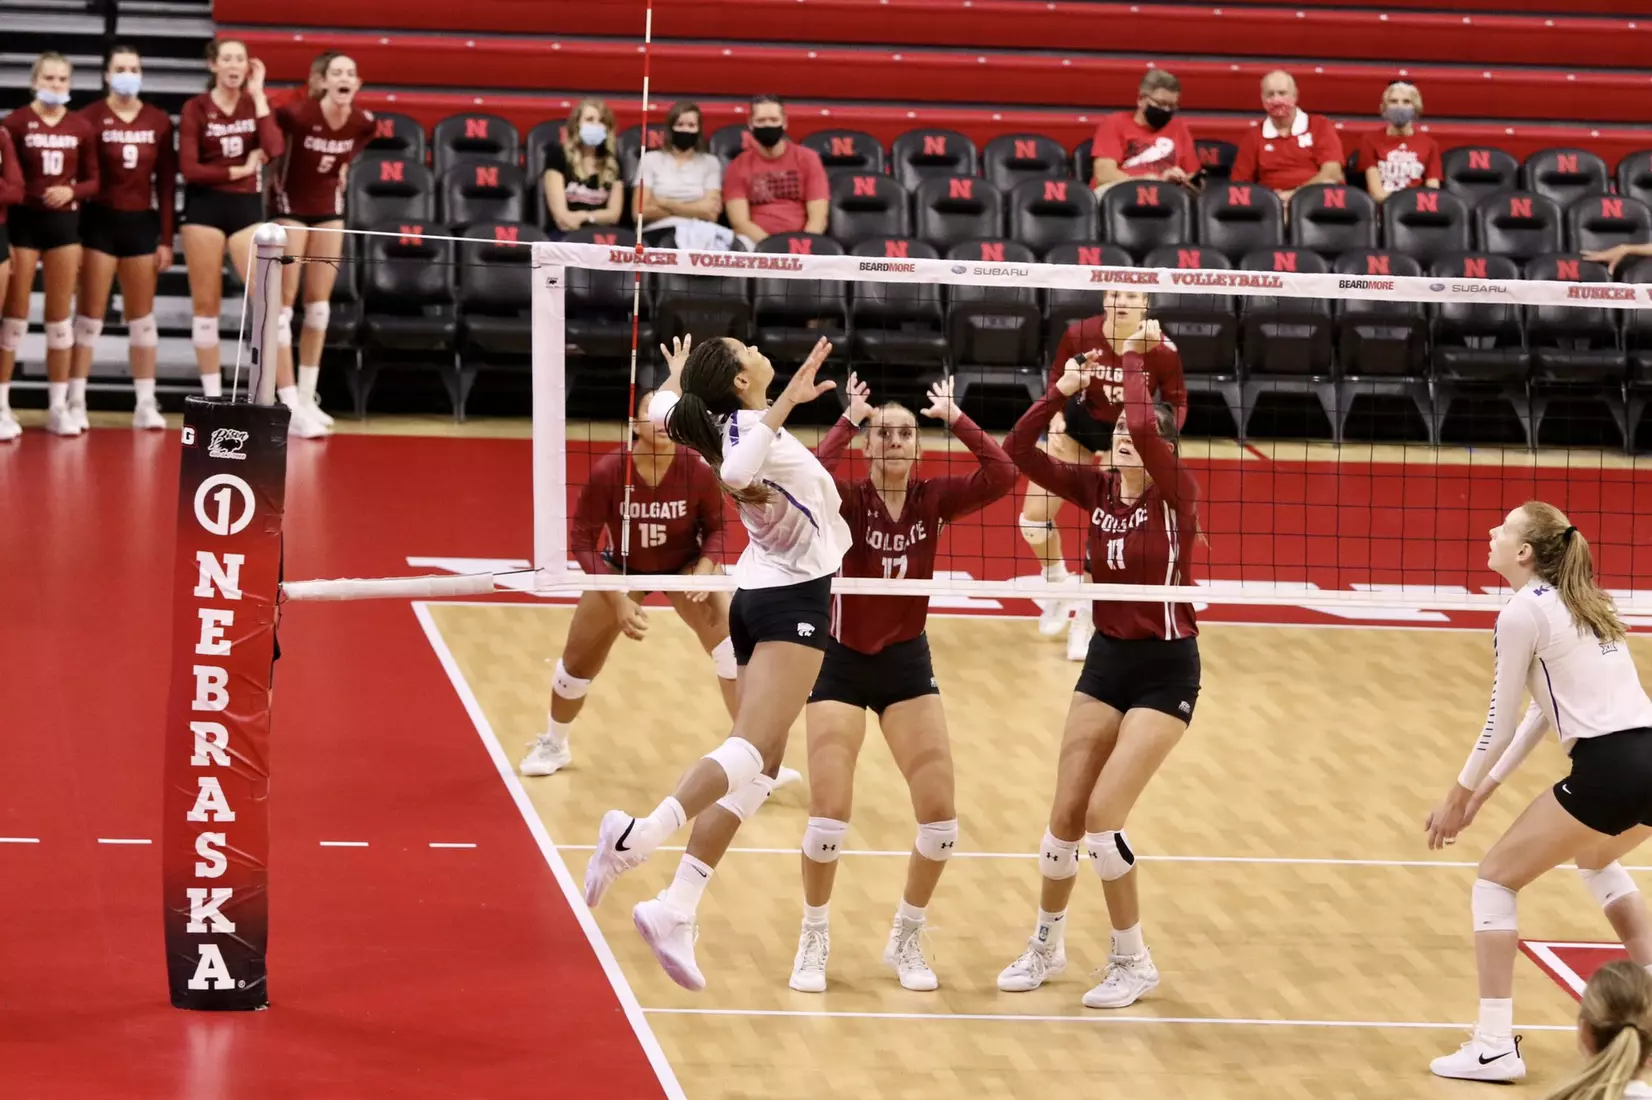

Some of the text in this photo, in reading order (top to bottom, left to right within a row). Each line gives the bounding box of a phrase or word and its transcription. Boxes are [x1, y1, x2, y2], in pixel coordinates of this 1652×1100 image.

[465, 118, 488, 139] N
[832, 137, 854, 156] N
[924, 135, 946, 155] N
[1015, 139, 1037, 159] N
[41, 150, 64, 176] 10
[122, 144, 138, 169] 9
[317, 155, 336, 173] 5
[1468, 150, 1491, 169] N
[1557, 154, 1579, 173] N
[380, 160, 404, 182] N
[476, 166, 498, 187] N
[853, 176, 877, 197] N
[949, 177, 973, 200] N
[1043, 180, 1067, 202] N
[1136, 185, 1159, 206] N
[1228, 185, 1252, 207] N
[1323, 187, 1346, 209] N
[1416, 191, 1439, 213] N
[1510, 197, 1533, 218] N
[1601, 198, 1625, 219] N
[399, 224, 423, 246] N
[494, 225, 519, 247] N
[787, 237, 812, 255] N
[885, 239, 909, 258] N
[980, 242, 1005, 262] N
[1078, 246, 1102, 266] N
[609, 249, 803, 271] HUSKER VOLLEYBALL
[859, 261, 916, 273] BEARDMORE
[1177, 249, 1201, 269] N
[1273, 251, 1297, 272] N
[1367, 255, 1390, 275] N
[1464, 258, 1488, 279] N
[1557, 259, 1581, 280] N
[973, 267, 1029, 277] SUBARU
[1090, 269, 1284, 289] HUSKER VOLLEYBALL
[1338, 279, 1394, 291] BEARDMORE
[1451, 284, 1507, 293] SUBARU
[1567, 285, 1637, 301] HUSKER
[638, 522, 667, 548] 15
[1107, 536, 1126, 570] 11
[881, 555, 908, 579] 17
[186, 550, 245, 990] NEBRASKA
